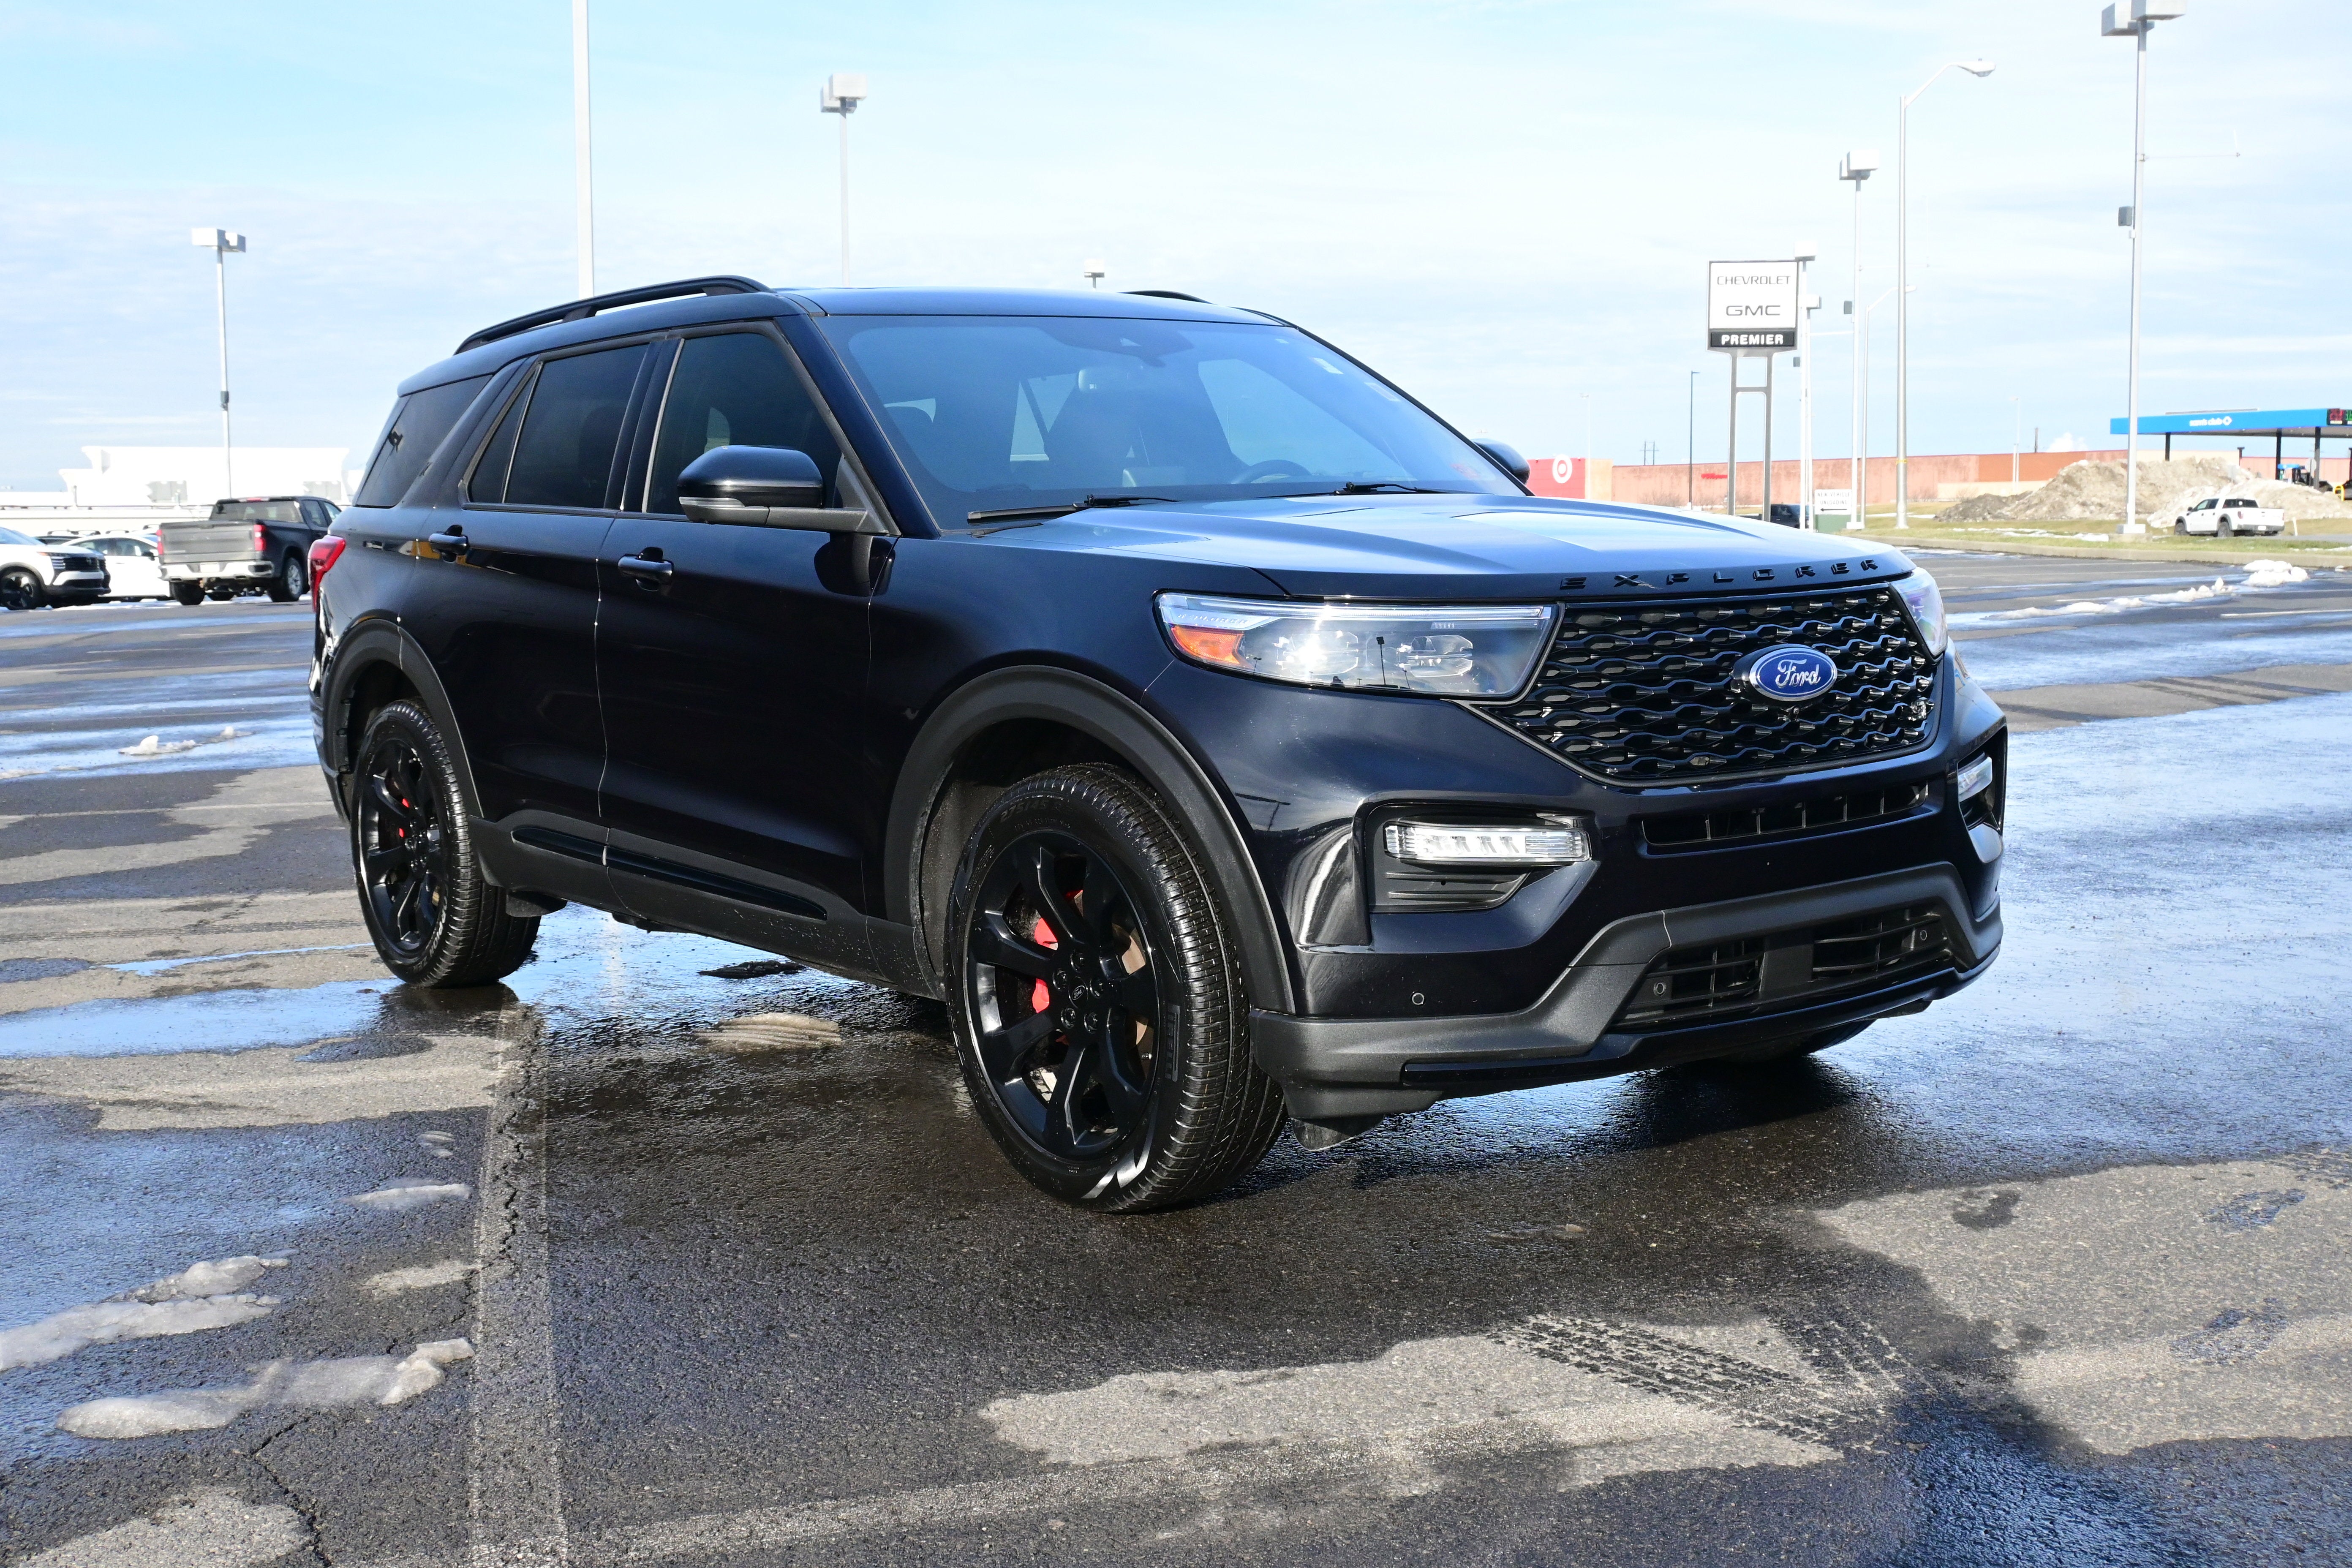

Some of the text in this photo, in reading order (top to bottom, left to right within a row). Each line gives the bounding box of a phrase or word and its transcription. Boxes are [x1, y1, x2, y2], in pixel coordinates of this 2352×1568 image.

[1717, 275, 1791, 285] CHEVROLET
[1726, 305, 1781, 316] GMC
[1721, 334, 1783, 345] PREMIER
[1560, 559, 1879, 590] EXPLORER
[1775, 659, 1821, 688] Ford
[1073, 988, 1082, 999] Ford
